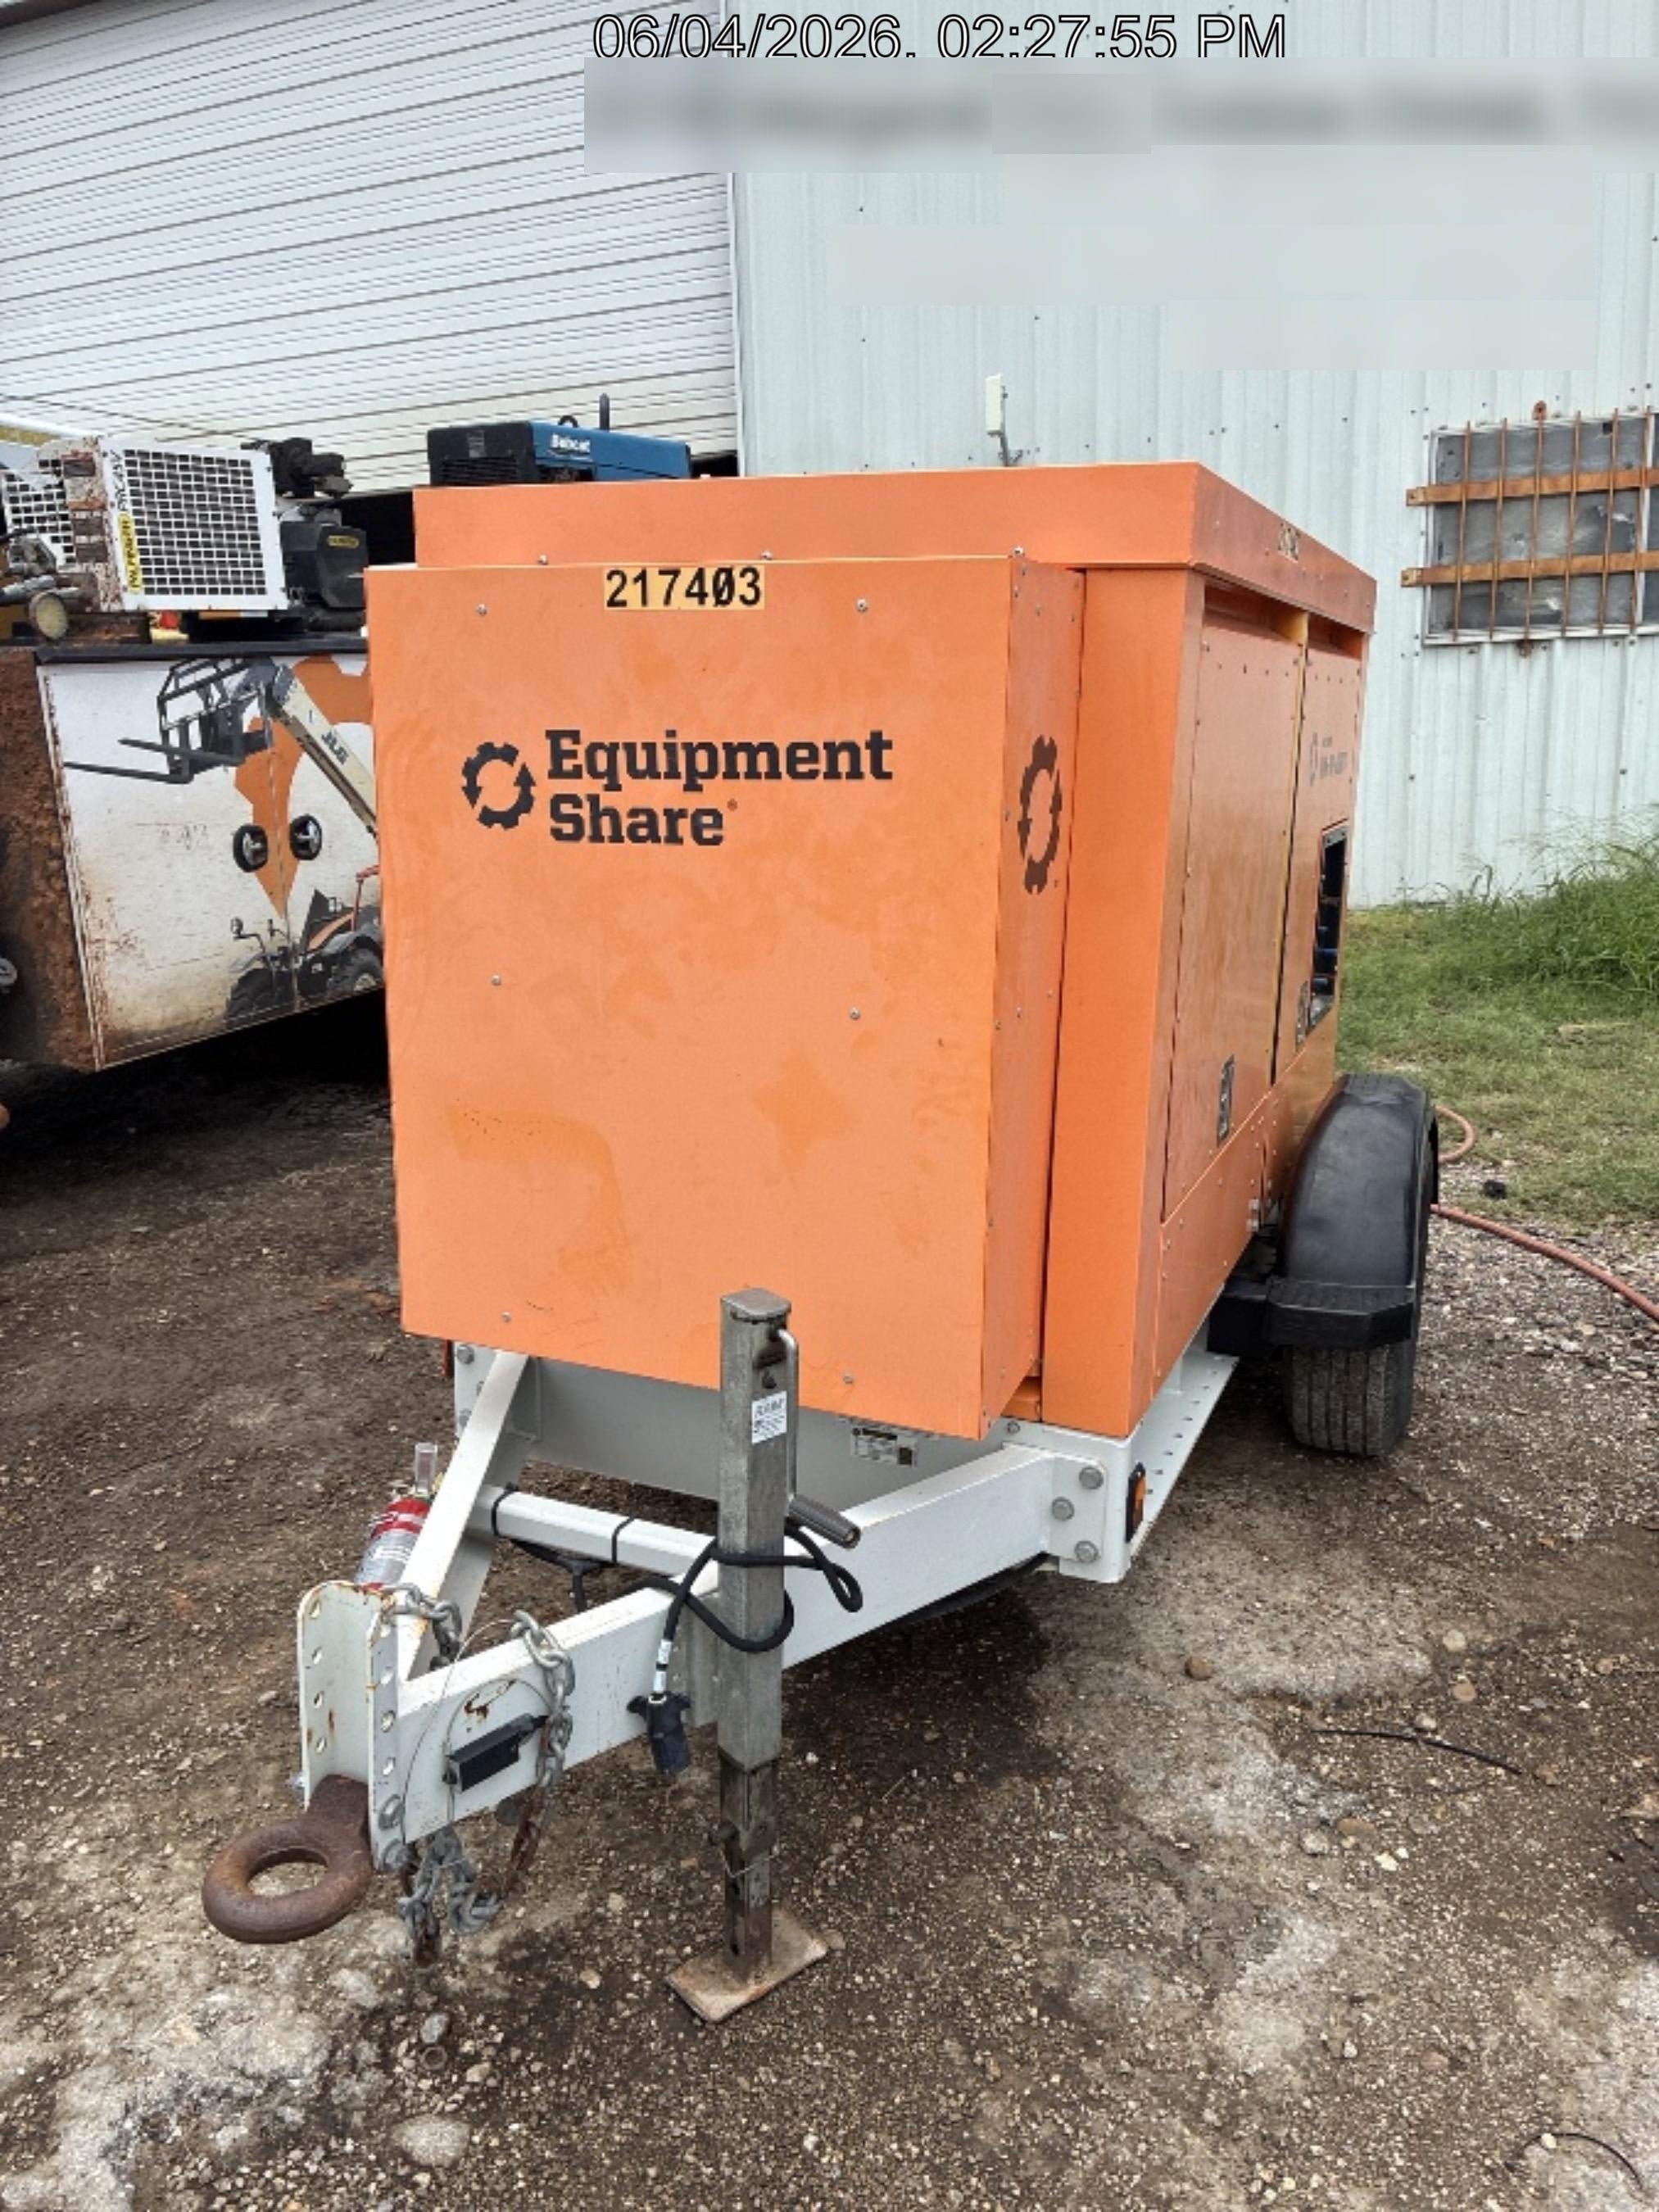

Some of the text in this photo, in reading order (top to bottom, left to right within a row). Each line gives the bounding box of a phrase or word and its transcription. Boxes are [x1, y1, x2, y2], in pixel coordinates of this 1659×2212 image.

[606, 567, 760, 607] 217403
[545, 729, 893, 792] Equipment
[550, 793, 723, 845] Share
